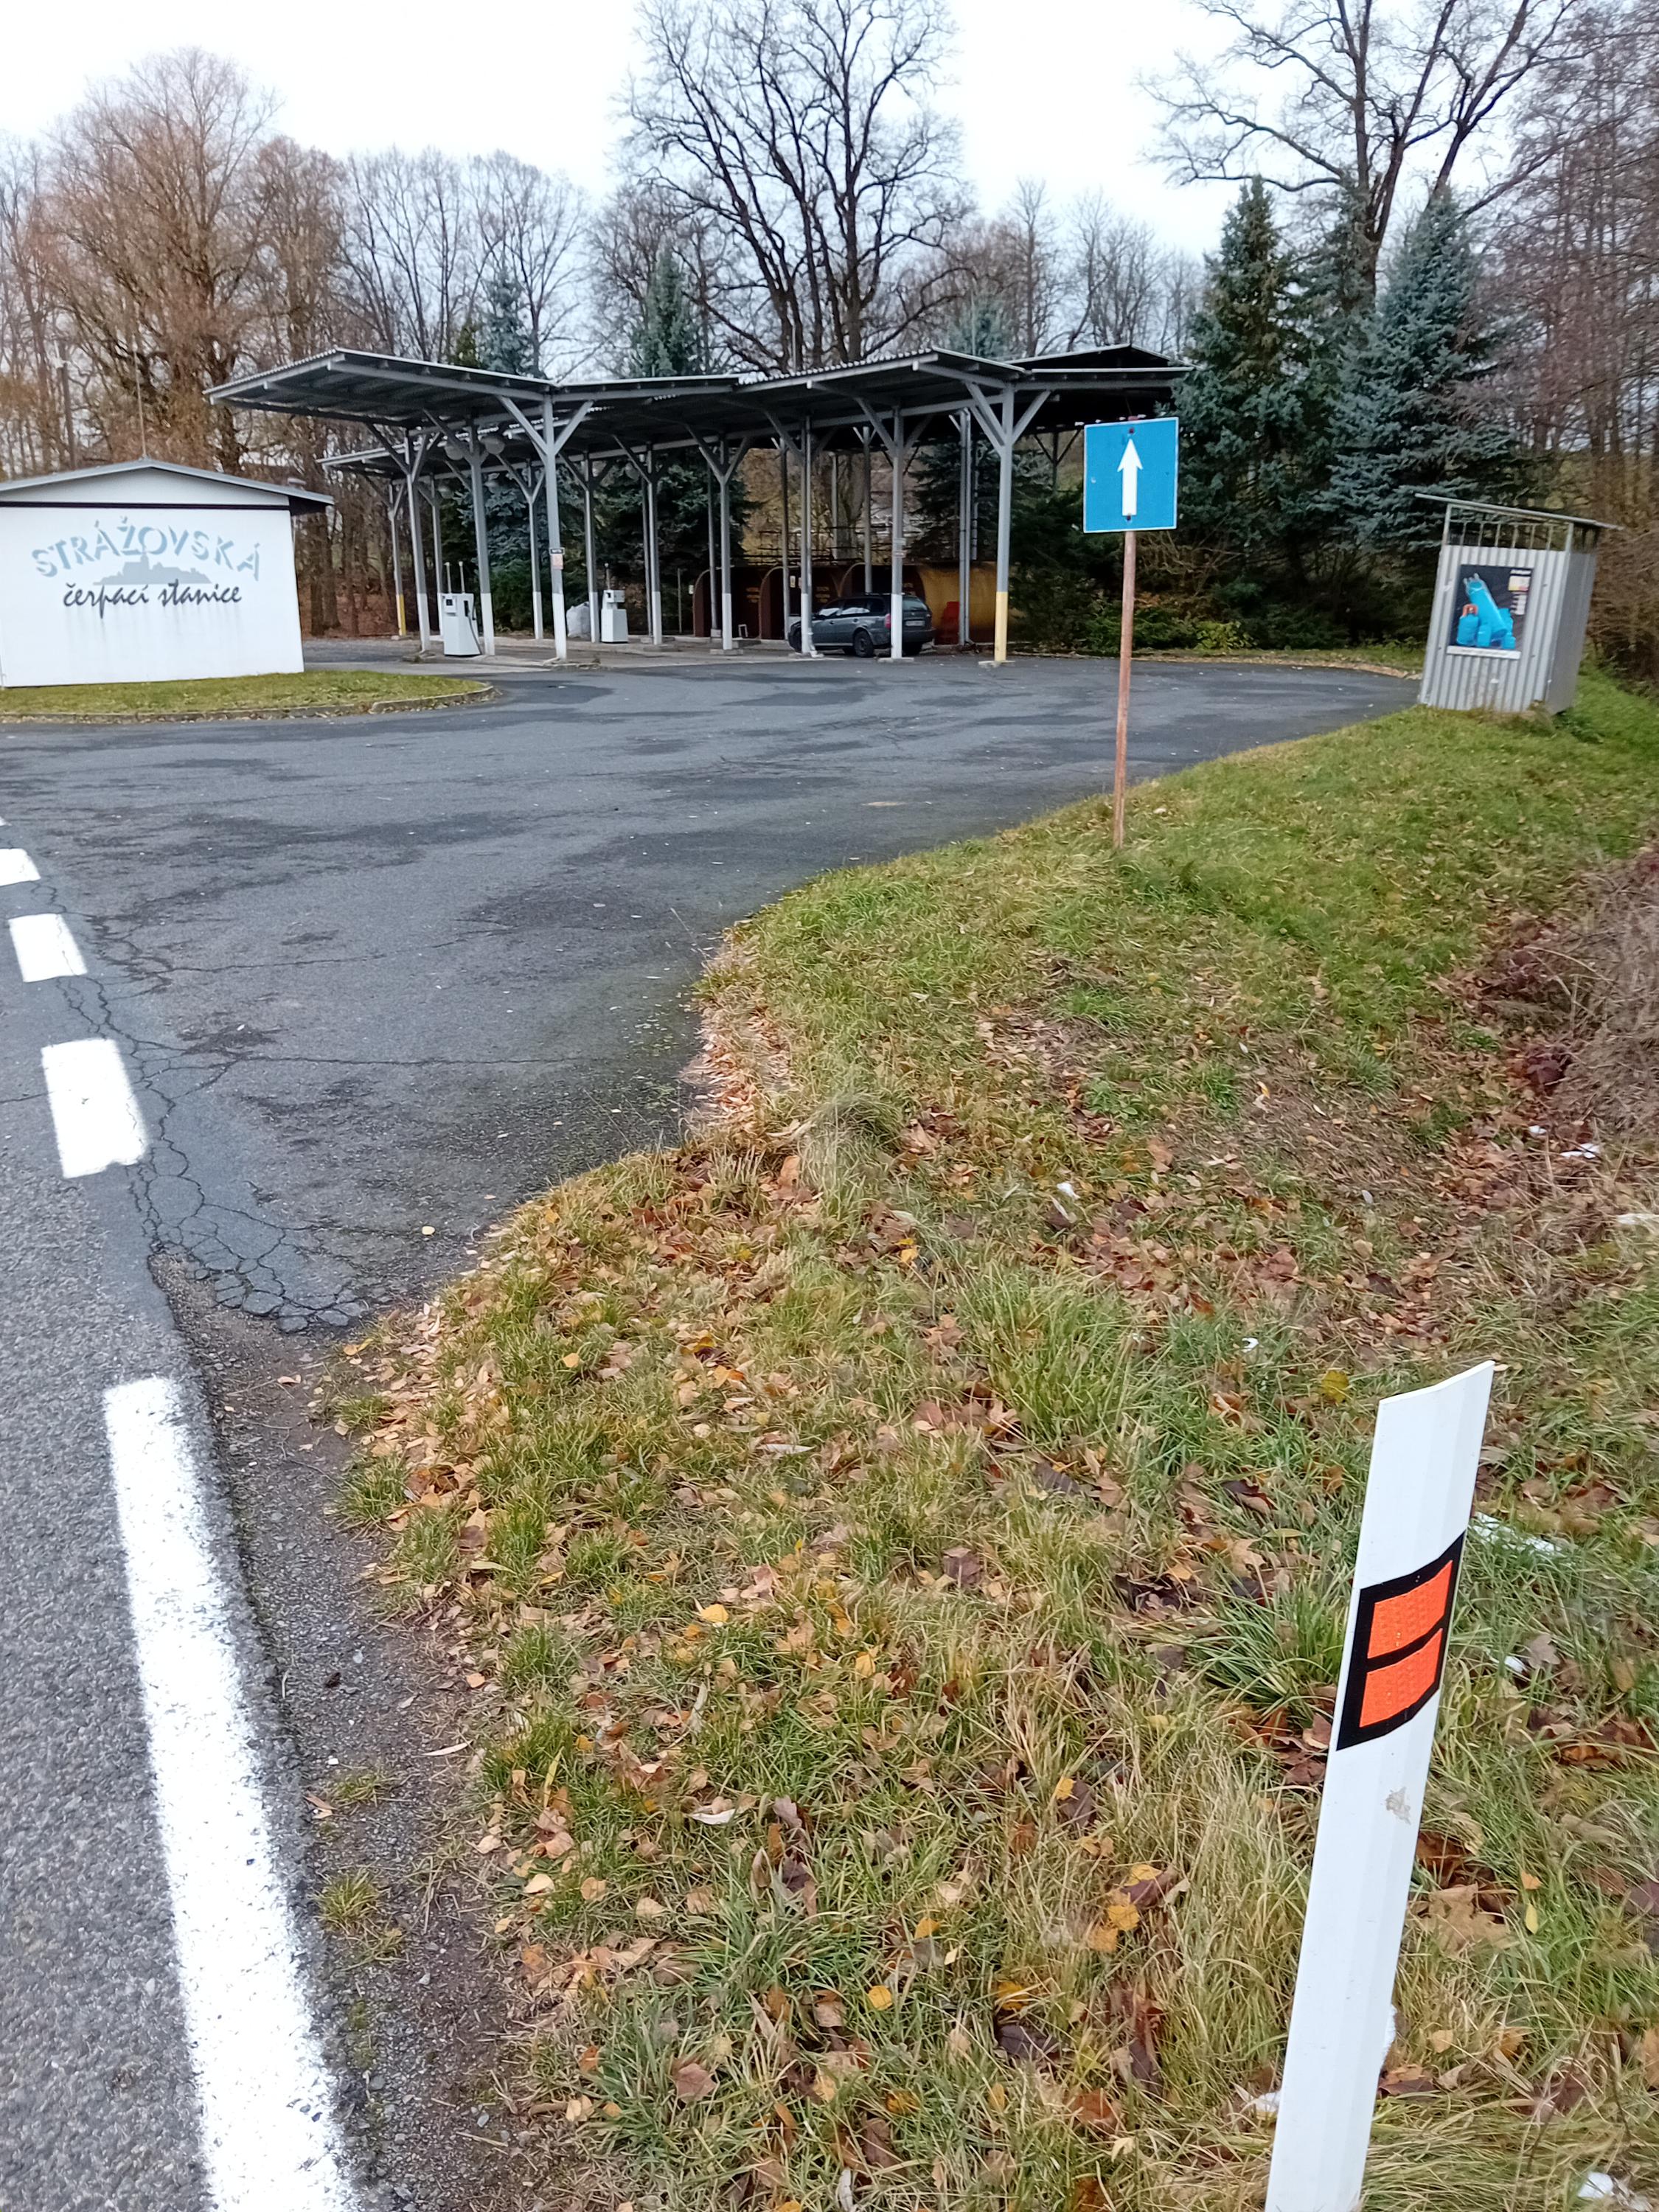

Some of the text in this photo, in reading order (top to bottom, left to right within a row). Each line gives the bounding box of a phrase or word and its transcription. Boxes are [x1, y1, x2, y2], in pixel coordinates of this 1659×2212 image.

[32, 515, 260, 582] STRÁŽOVSKÁ
[63, 578, 243, 619] čerpací stanice
